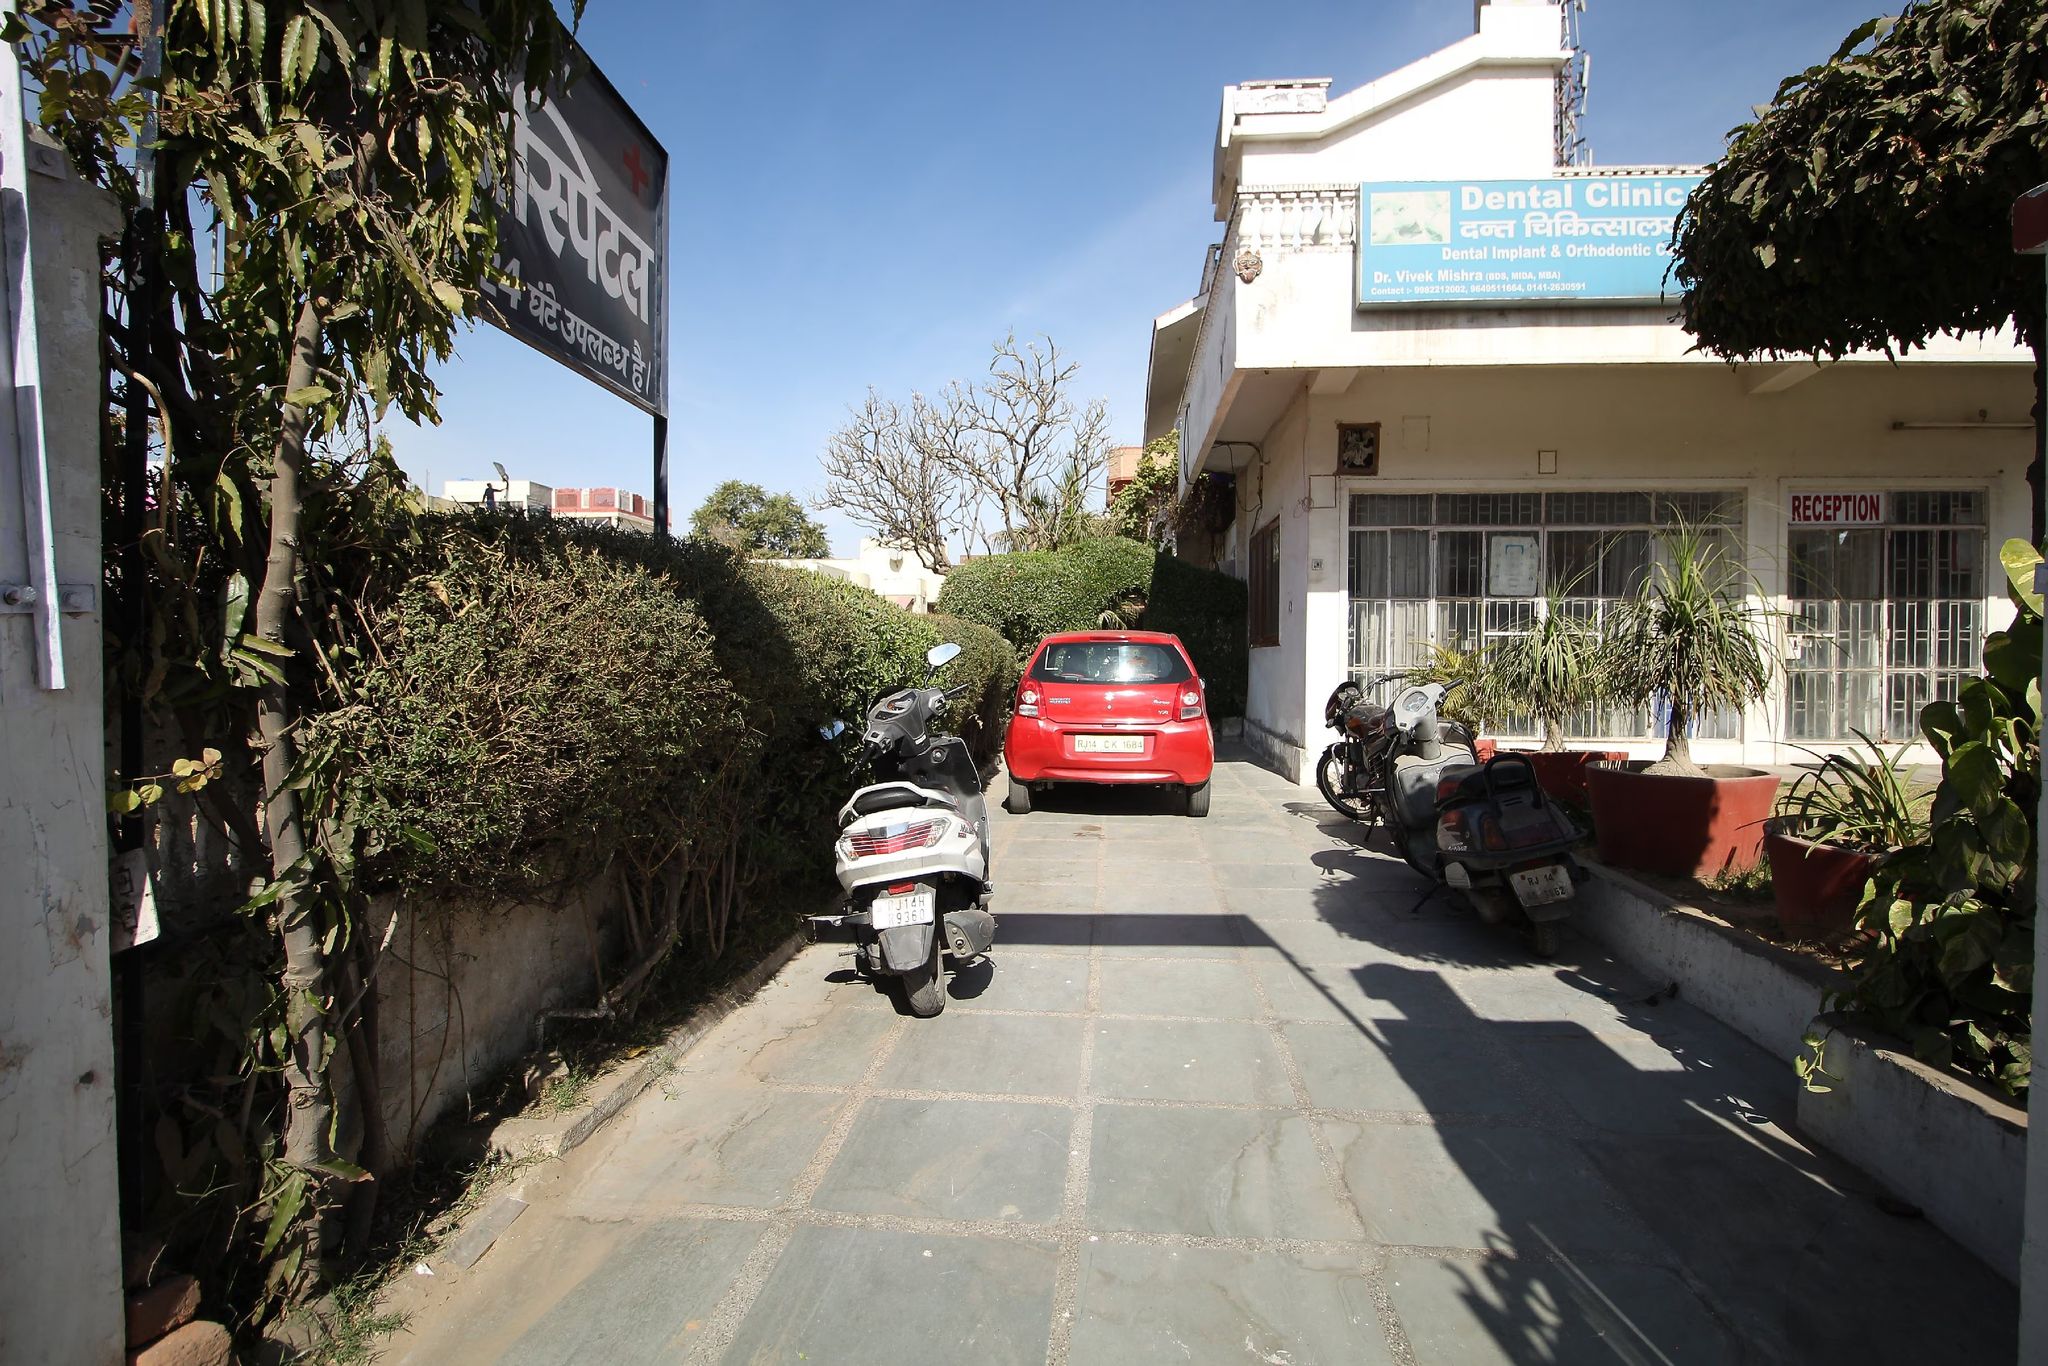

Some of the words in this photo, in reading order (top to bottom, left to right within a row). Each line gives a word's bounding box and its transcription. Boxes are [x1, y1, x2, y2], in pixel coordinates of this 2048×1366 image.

[510, 79, 654, 325] स्पिटल
[1460, 183, 1573, 211] Dental
[1585, 181, 1685, 208] Clinic
[1459, 219, 1516, 239] दन्त
[1442, 246, 1487, 260] Dental
[1492, 245, 1546, 262] Implant
[1550, 244, 1561, 258] &
[1566, 241, 1651, 258] Orthodontic
[1373, 271, 1392, 284] Dr.
[1396, 269, 1433, 283] Vivek
[1437, 268, 1483, 282] Mishra
[1538, 270, 1561, 280] MBA)
[1371, 286, 1404, 295] Contact
[527, 281, 562, 331] घंटे
[560, 307, 630, 379] उपलब्ध
[1791, 494, 1880, 522] RECEPTION
